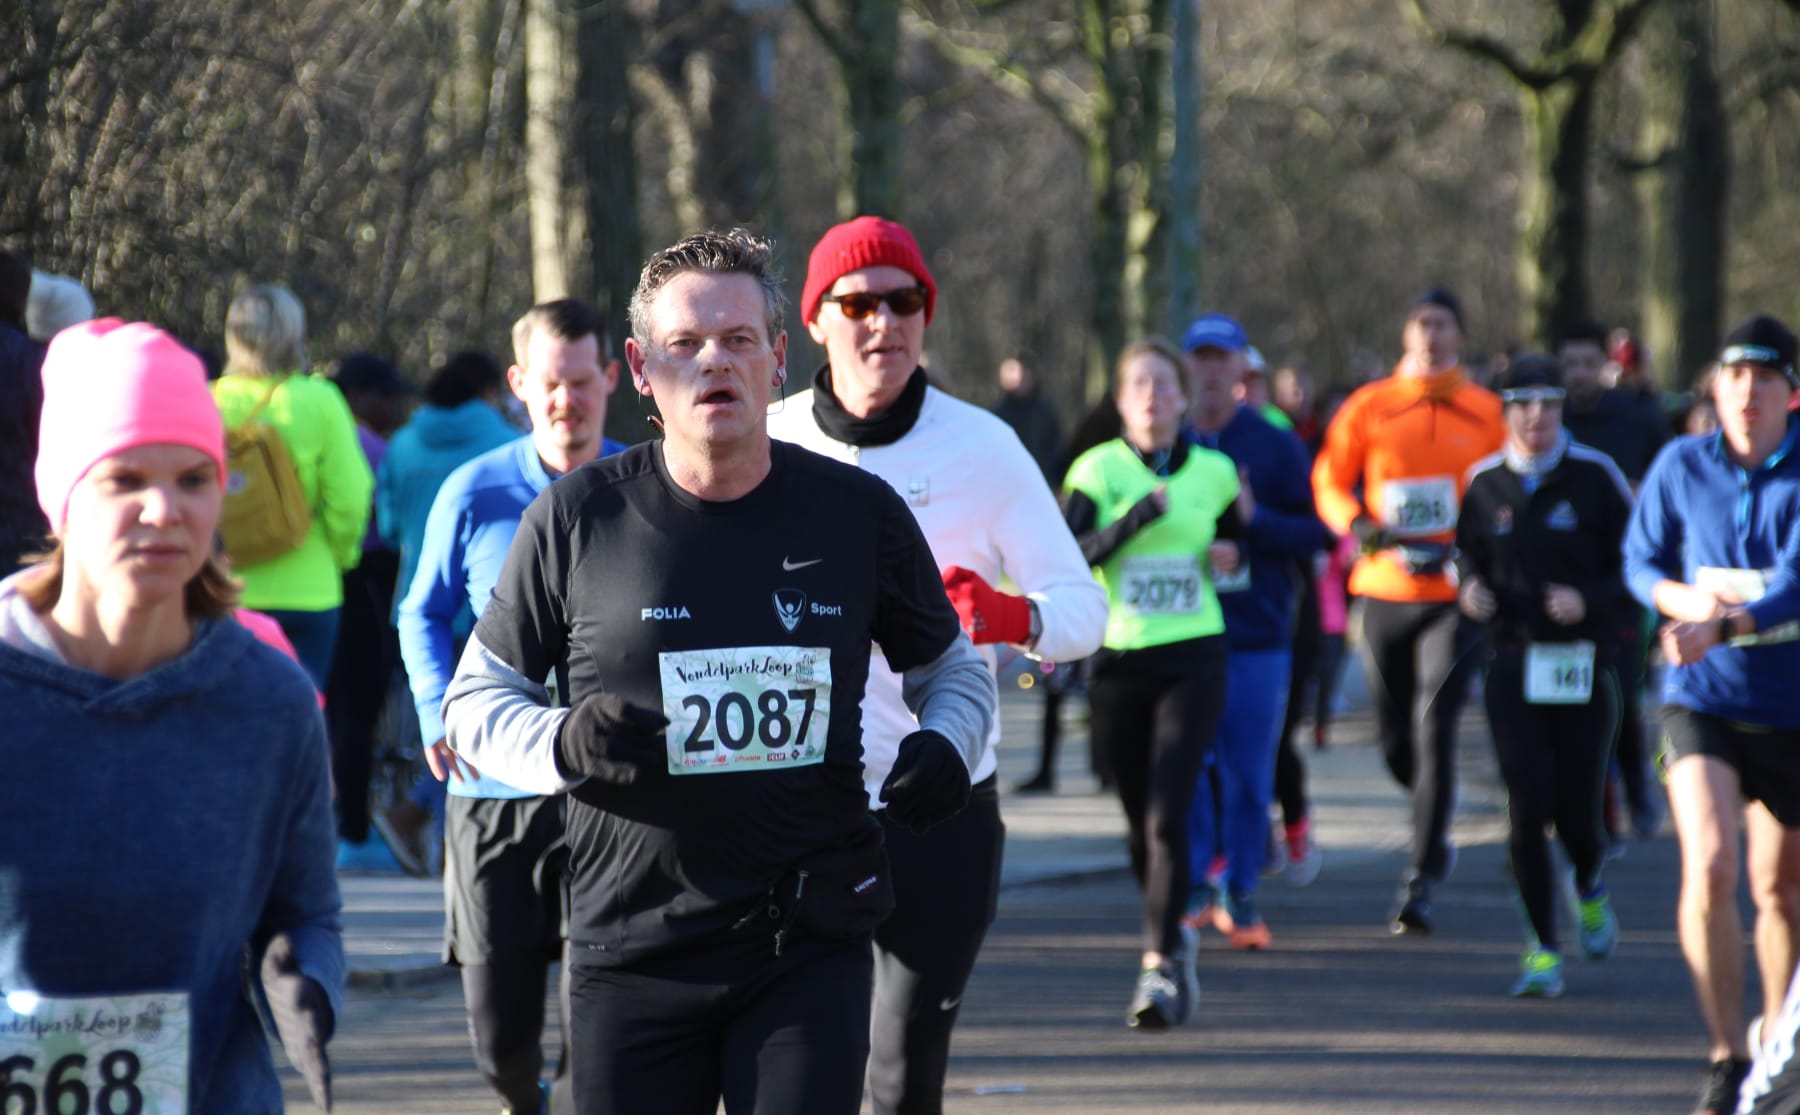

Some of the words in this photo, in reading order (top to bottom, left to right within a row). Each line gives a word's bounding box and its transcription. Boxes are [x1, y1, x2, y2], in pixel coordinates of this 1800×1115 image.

[641, 606, 691, 621] FOLIA
[811, 602, 842, 616] Sport
[682, 688, 816, 753] 2087
[0, 1049, 143, 1115] 668
